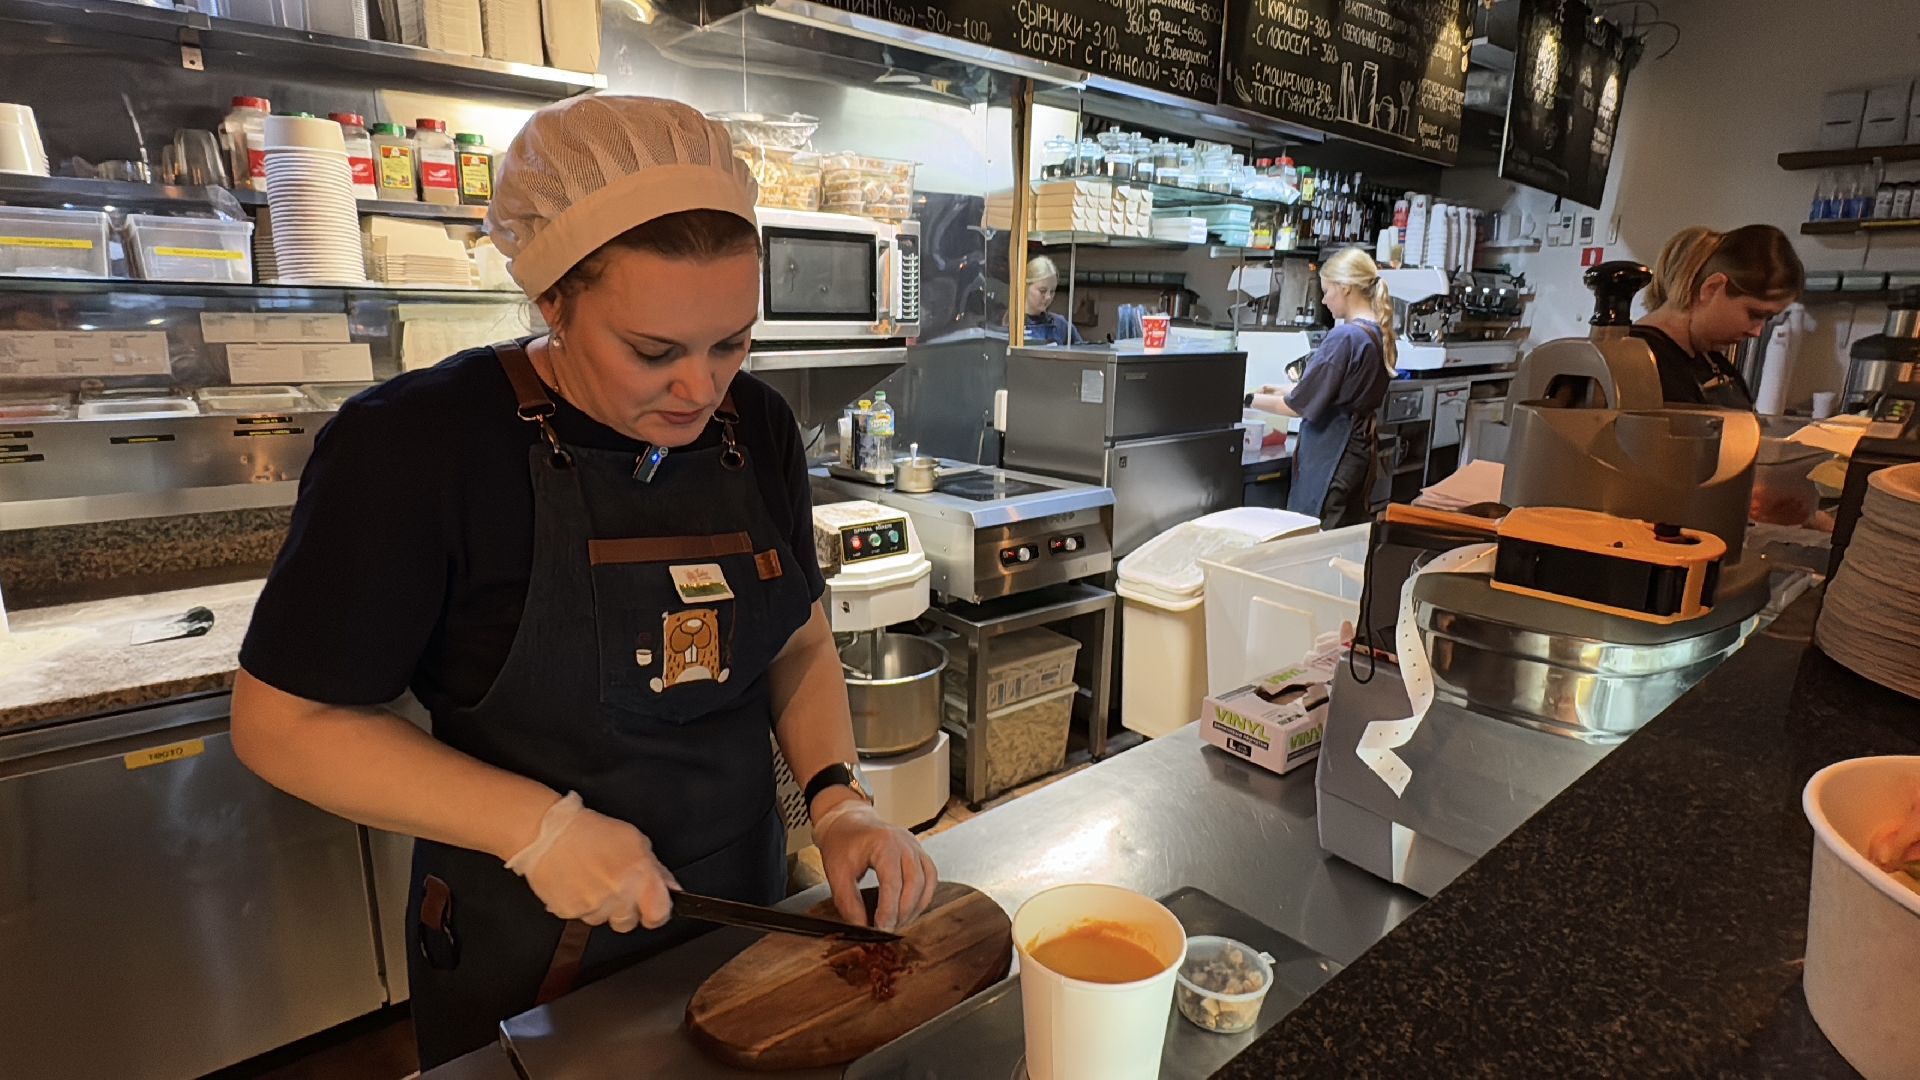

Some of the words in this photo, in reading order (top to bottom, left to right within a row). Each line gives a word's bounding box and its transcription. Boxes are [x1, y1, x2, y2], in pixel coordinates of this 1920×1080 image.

[1018, 0, 1083, 40] СЫРНИКИ
[1020, 26, 1076, 60] ЙОГУРТ
[1101, 50, 1160, 81] ГРАНОЛОЙ
[1266, 26, 1310, 56] ЛОСОСЕМ
[1252, 81, 1275, 106] ТОСТ
[1215, 705, 1271, 743] VINYL
